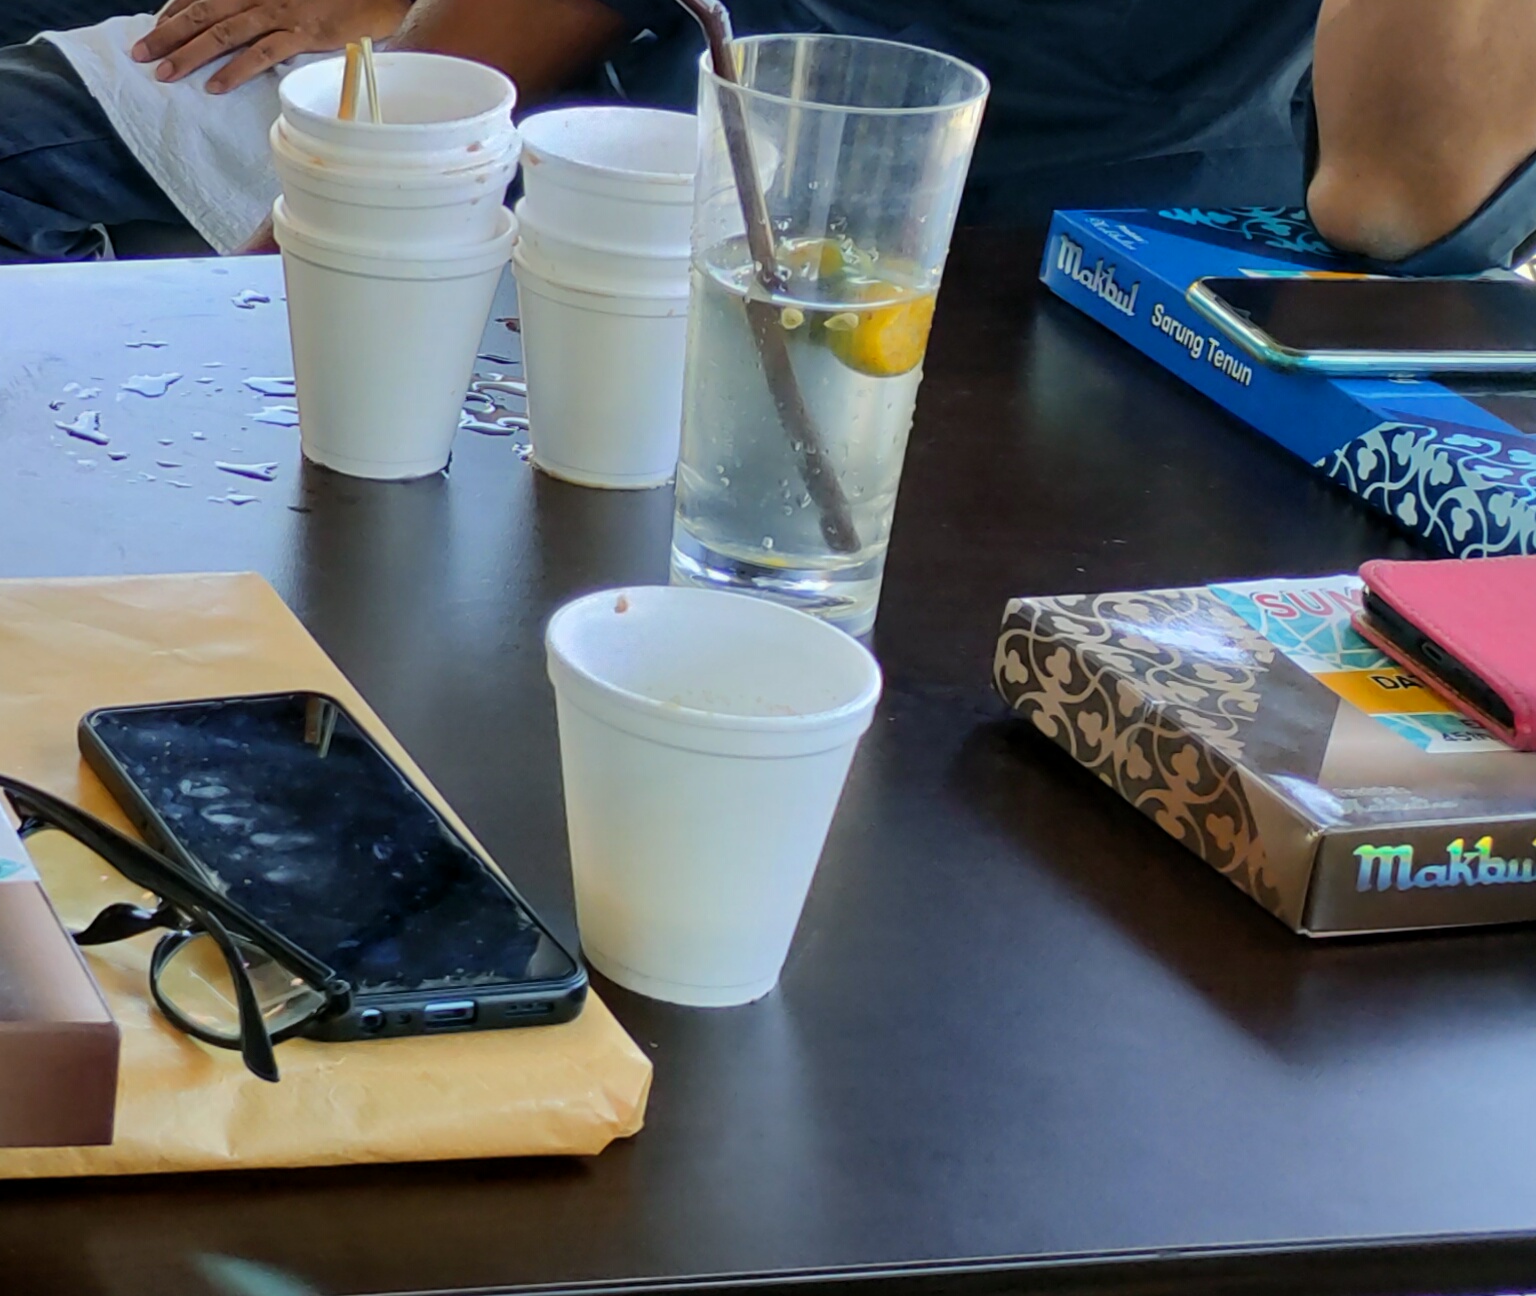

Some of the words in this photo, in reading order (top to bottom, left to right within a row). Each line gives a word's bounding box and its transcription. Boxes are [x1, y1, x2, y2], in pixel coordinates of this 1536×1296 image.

[1056, 234, 1136, 317] Makbul
[1151, 304, 1204, 359] Sarung
[1207, 337, 1253, 386] Tenun
[1353, 835, 1536, 892] Makbu
